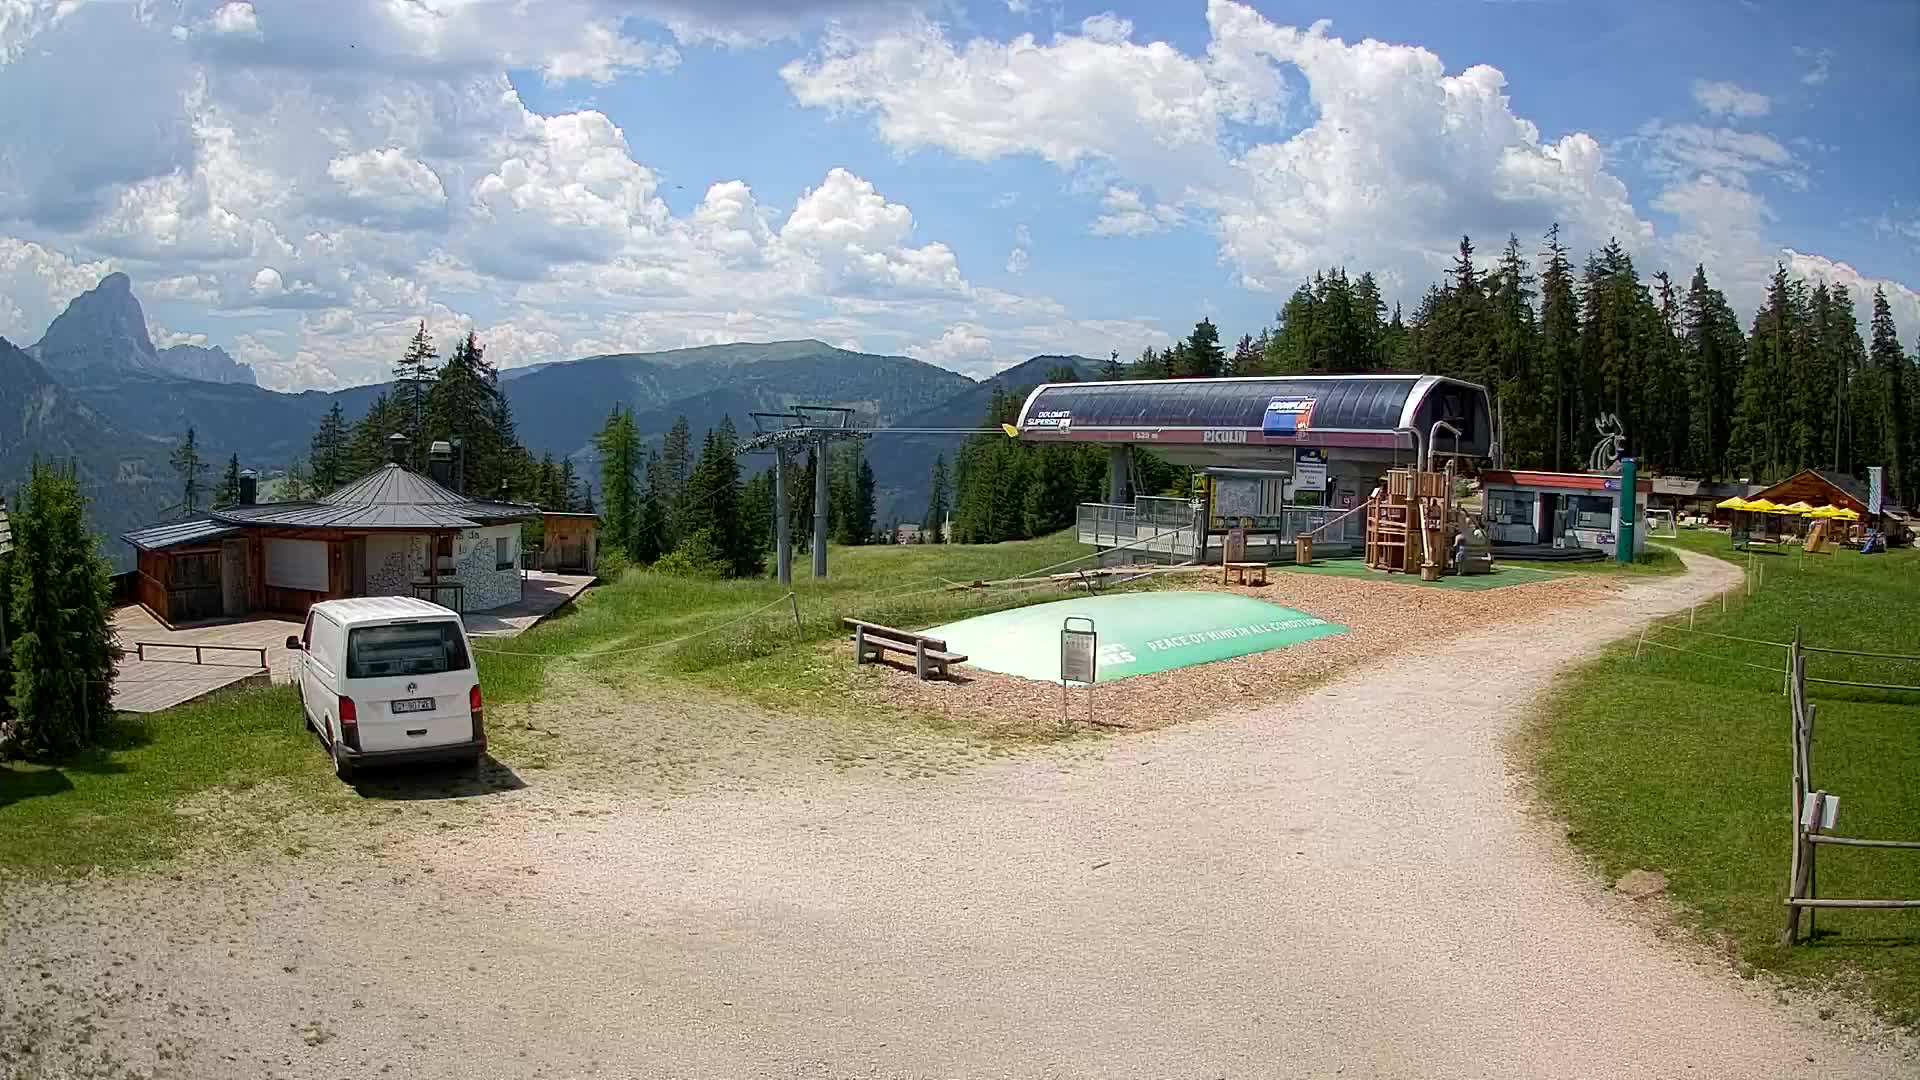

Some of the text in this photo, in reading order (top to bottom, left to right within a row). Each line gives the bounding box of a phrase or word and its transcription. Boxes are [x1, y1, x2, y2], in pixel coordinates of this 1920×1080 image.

[1203, 429, 1247, 443] PICULIN
[1146, 636, 1190, 652] PEACE
[1189, 633, 1205, 645] OF
[1206, 629, 1237, 641] MIND
[1234, 627, 1250, 637] IN
[1249, 623, 1272, 634] ALL
